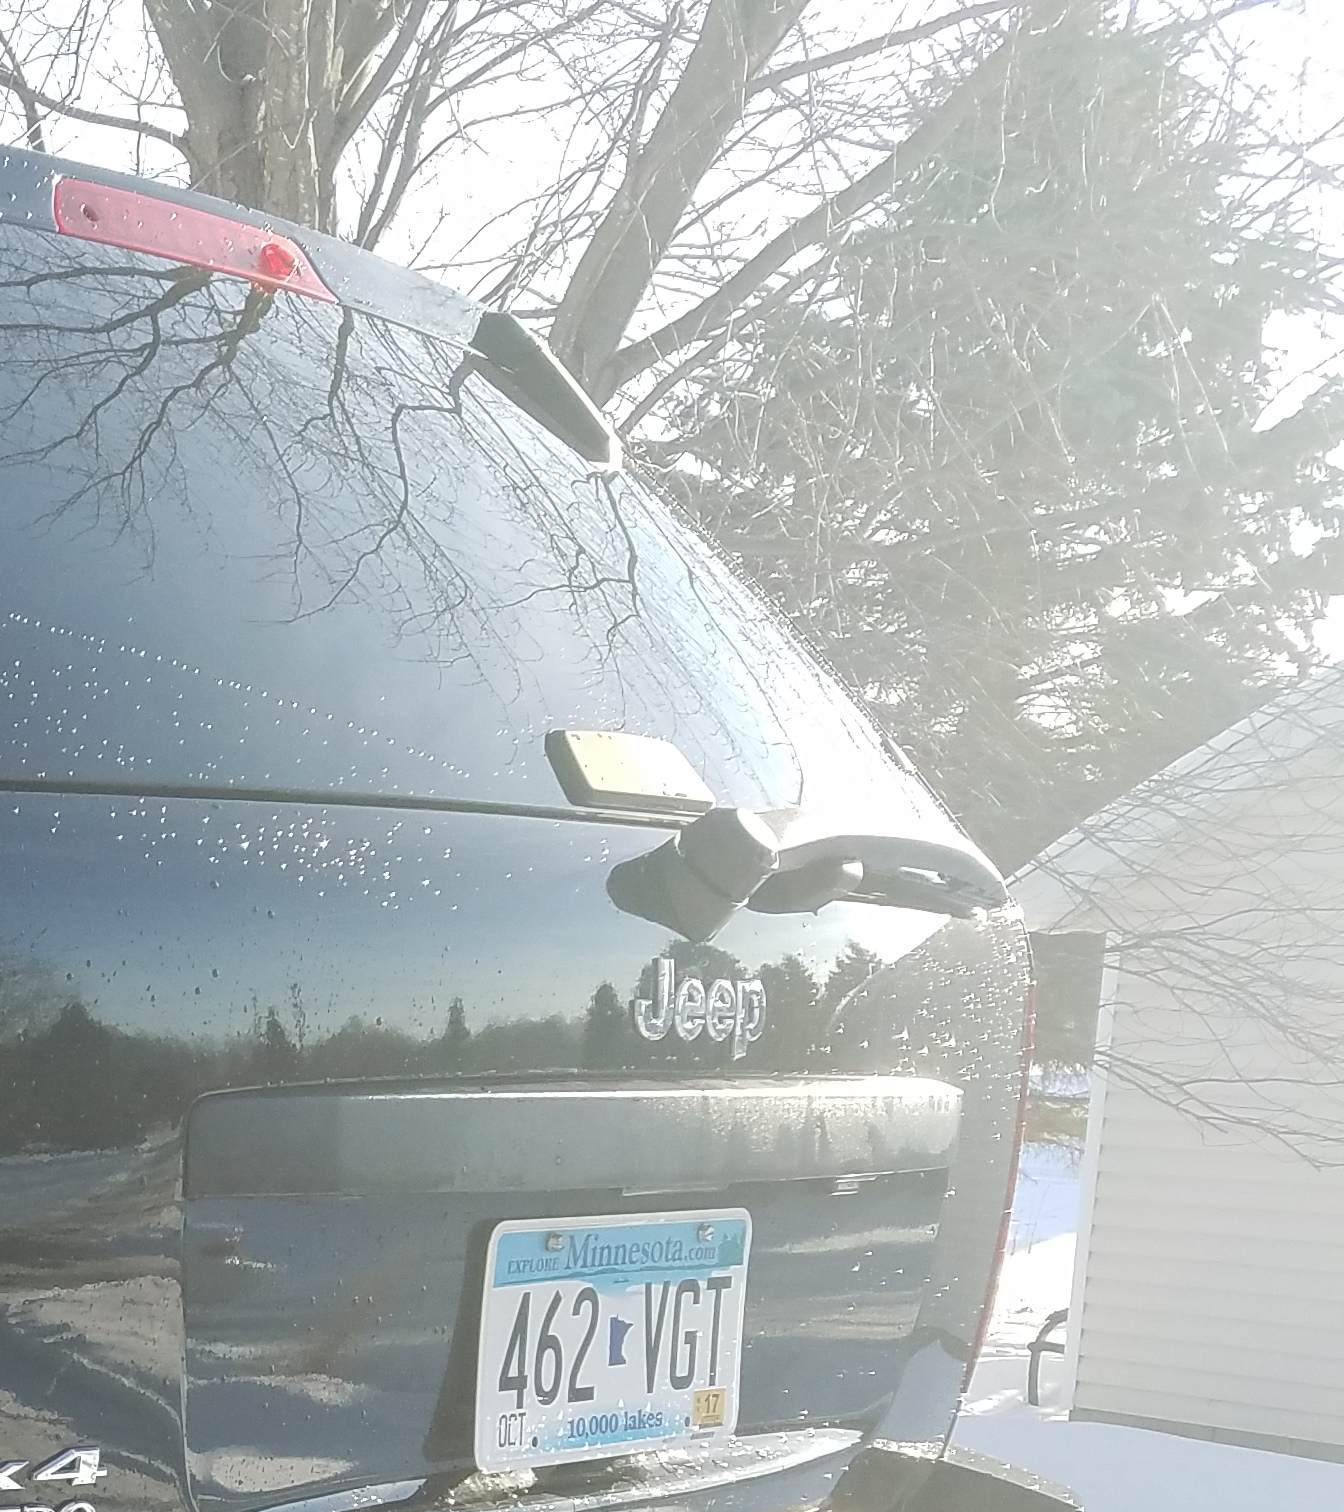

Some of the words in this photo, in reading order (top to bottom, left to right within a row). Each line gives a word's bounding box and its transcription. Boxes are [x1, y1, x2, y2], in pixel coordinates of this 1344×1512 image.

[634, 956, 767, 1061] Jeep
[507, 1257, 560, 1275] EXPLORE
[564, 1233, 716, 1270] Minnesota.com
[498, 1286, 601, 1410] 462
[644, 1275, 732, 1394] VGT
[704, 1393, 721, 1414] 17
[498, 1412, 527, 1448] OCT
[567, 1413, 619, 1439] 10,000
[623, 1409, 663, 1432] lakes
